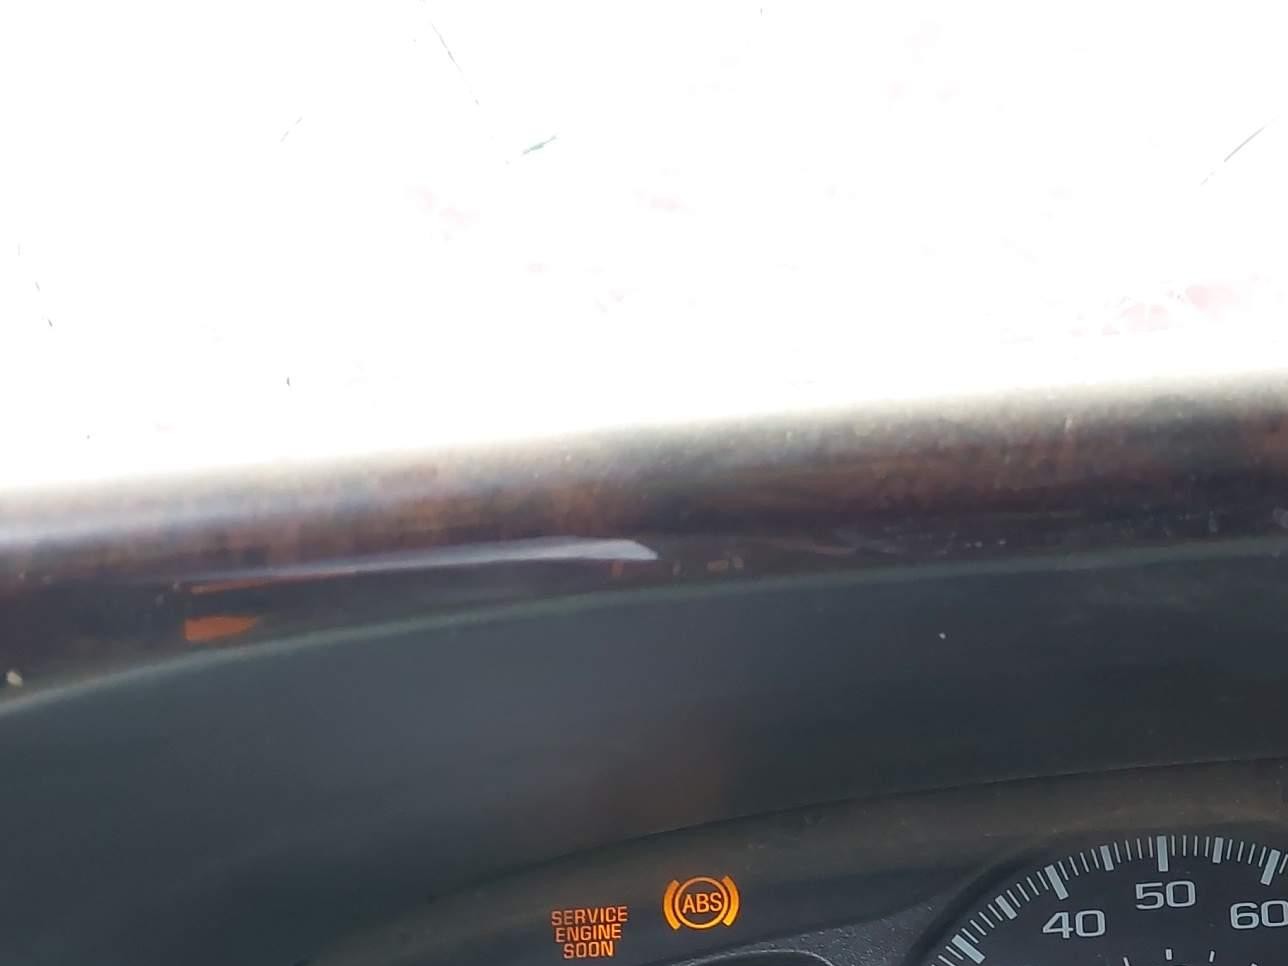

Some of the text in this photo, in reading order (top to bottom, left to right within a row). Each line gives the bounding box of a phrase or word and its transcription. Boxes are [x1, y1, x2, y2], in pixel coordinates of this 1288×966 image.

[682, 892, 723, 914] ABS
[1135, 880, 1196, 909] 50
[551, 906, 628, 926] SERVICE
[1042, 910, 1106, 939] 40
[555, 923, 622, 943] ENGINE
[563, 940, 613, 959] SOON
